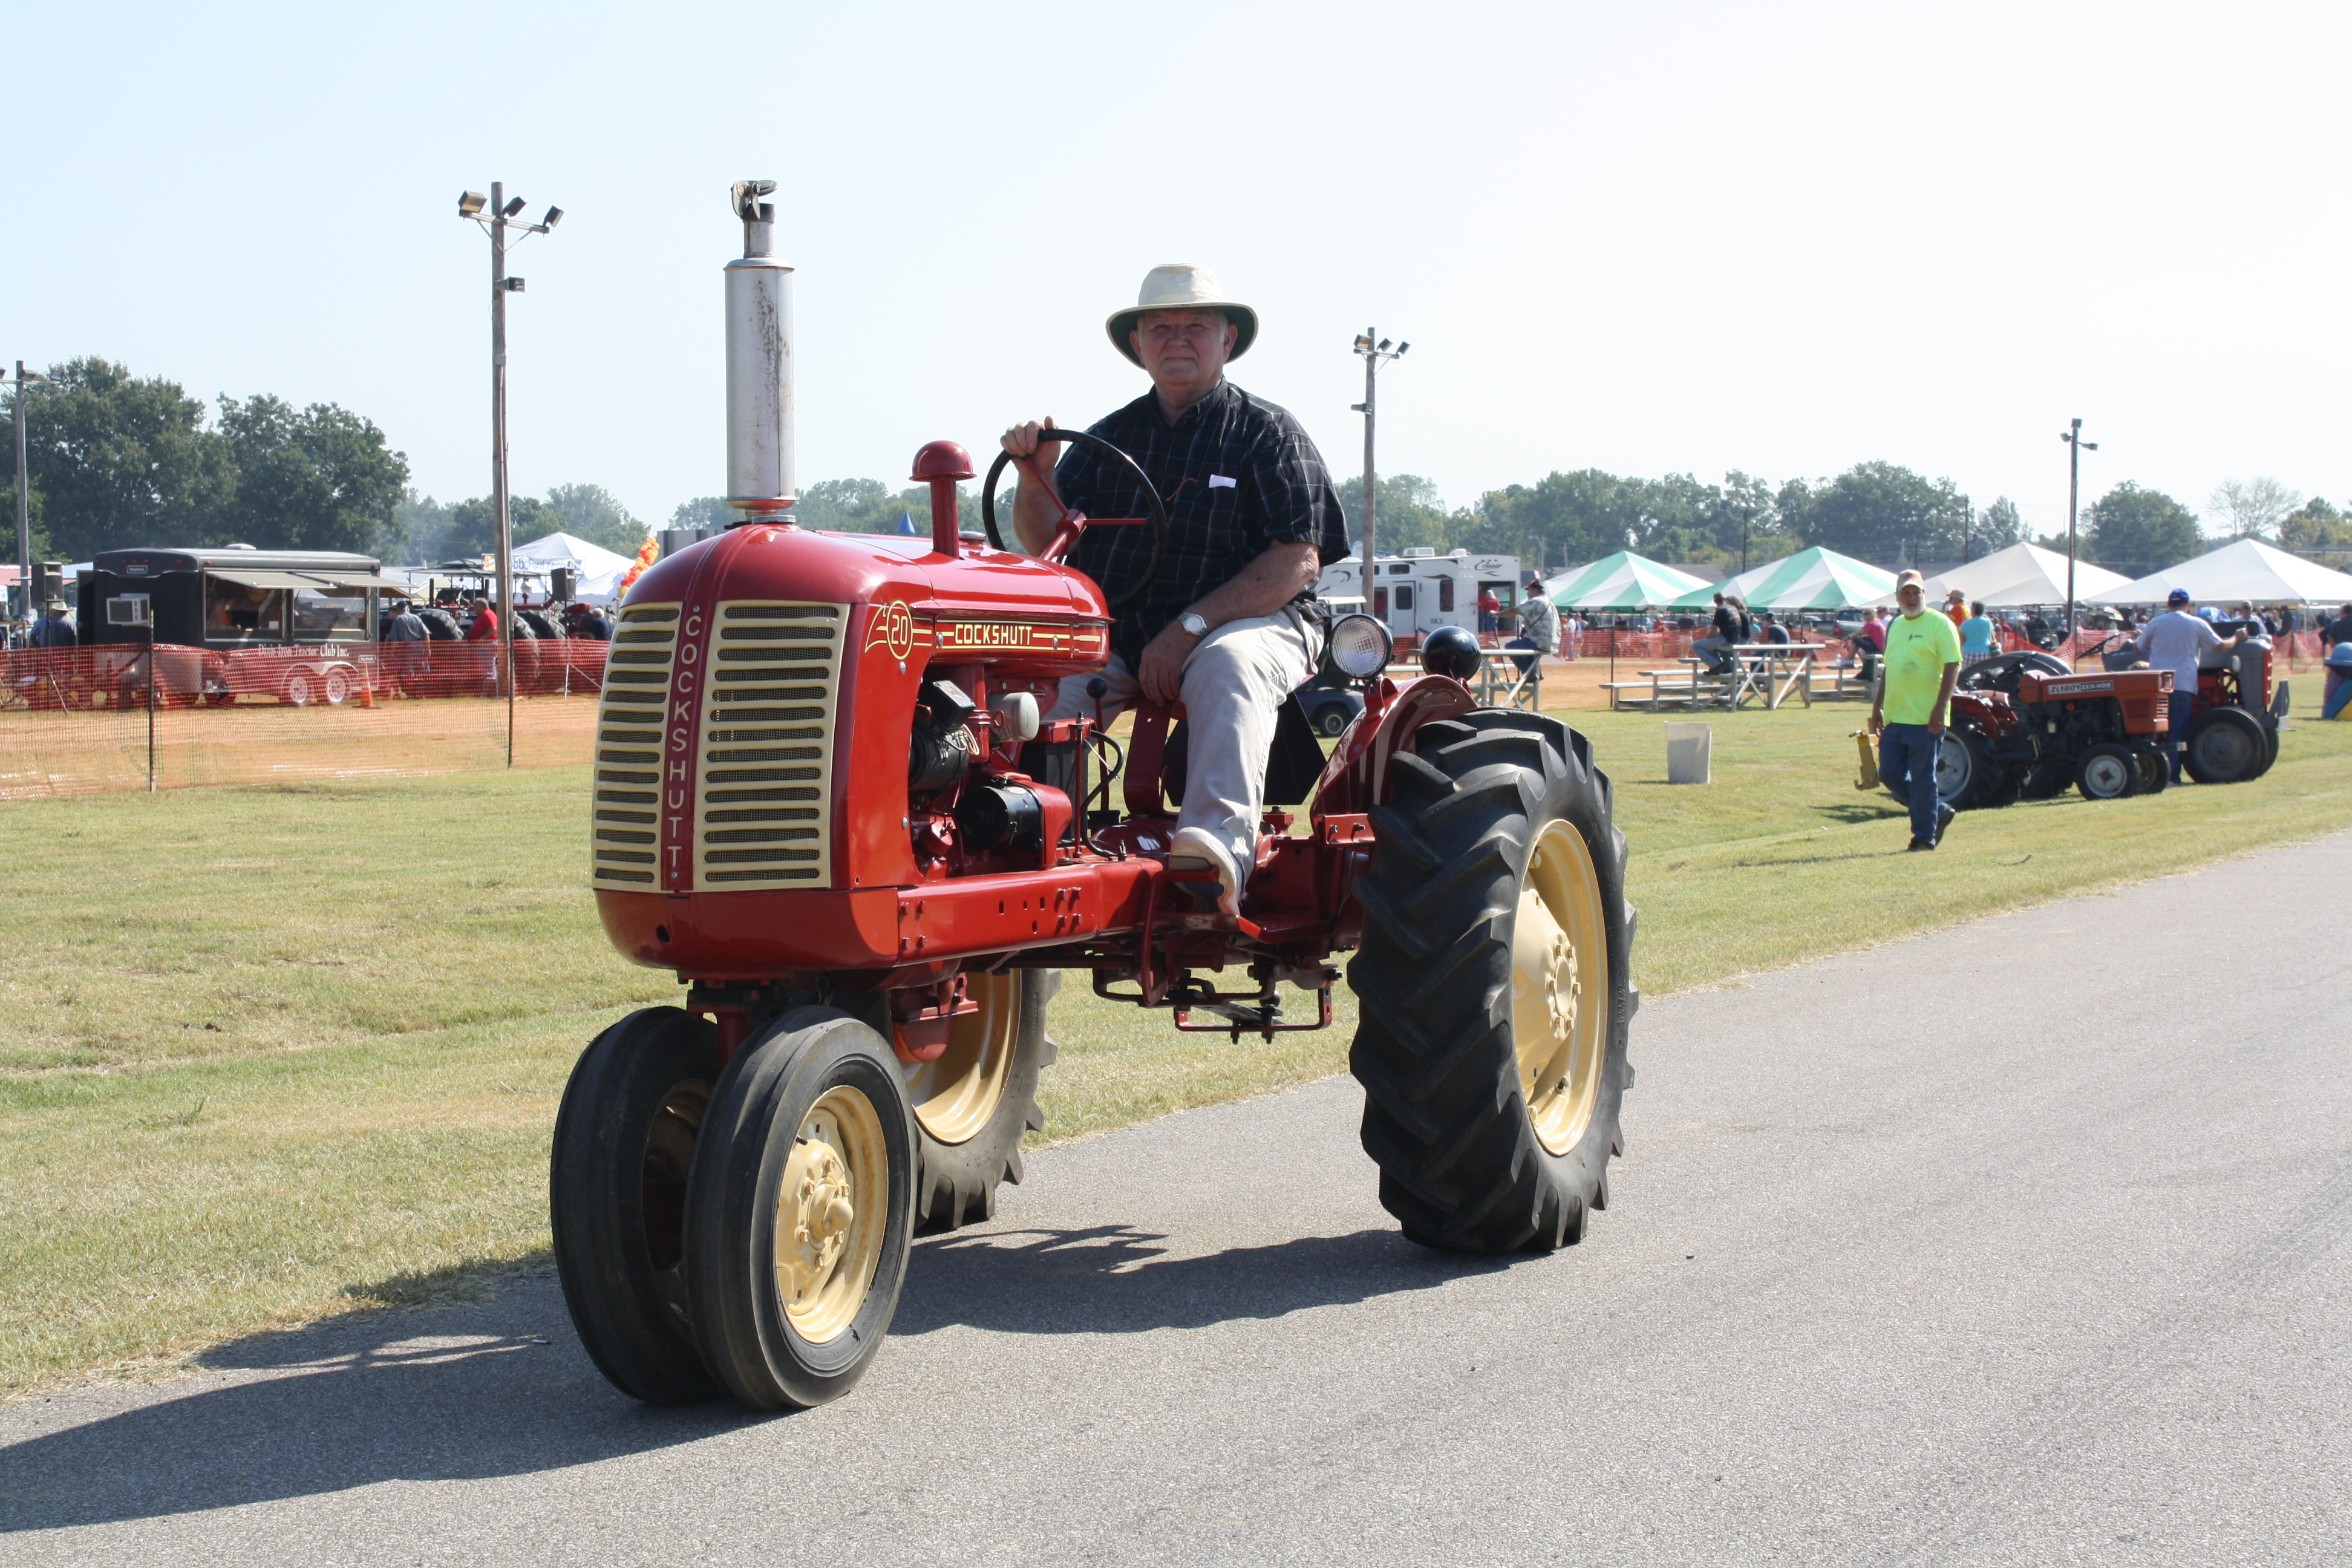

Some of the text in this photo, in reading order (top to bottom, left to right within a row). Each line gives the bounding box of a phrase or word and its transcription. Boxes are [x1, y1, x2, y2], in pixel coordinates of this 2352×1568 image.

[1474, 561, 1503, 571] Cougar
[892, 615, 907, 645] 20
[955, 624, 1033, 645] COCKSHUTT
[294, 644, 319, 656] Tractor
[320, 644, 336, 657] Club
[337, 645, 349, 657] Inc.
[667, 615, 702, 867] COCKSHUTT
